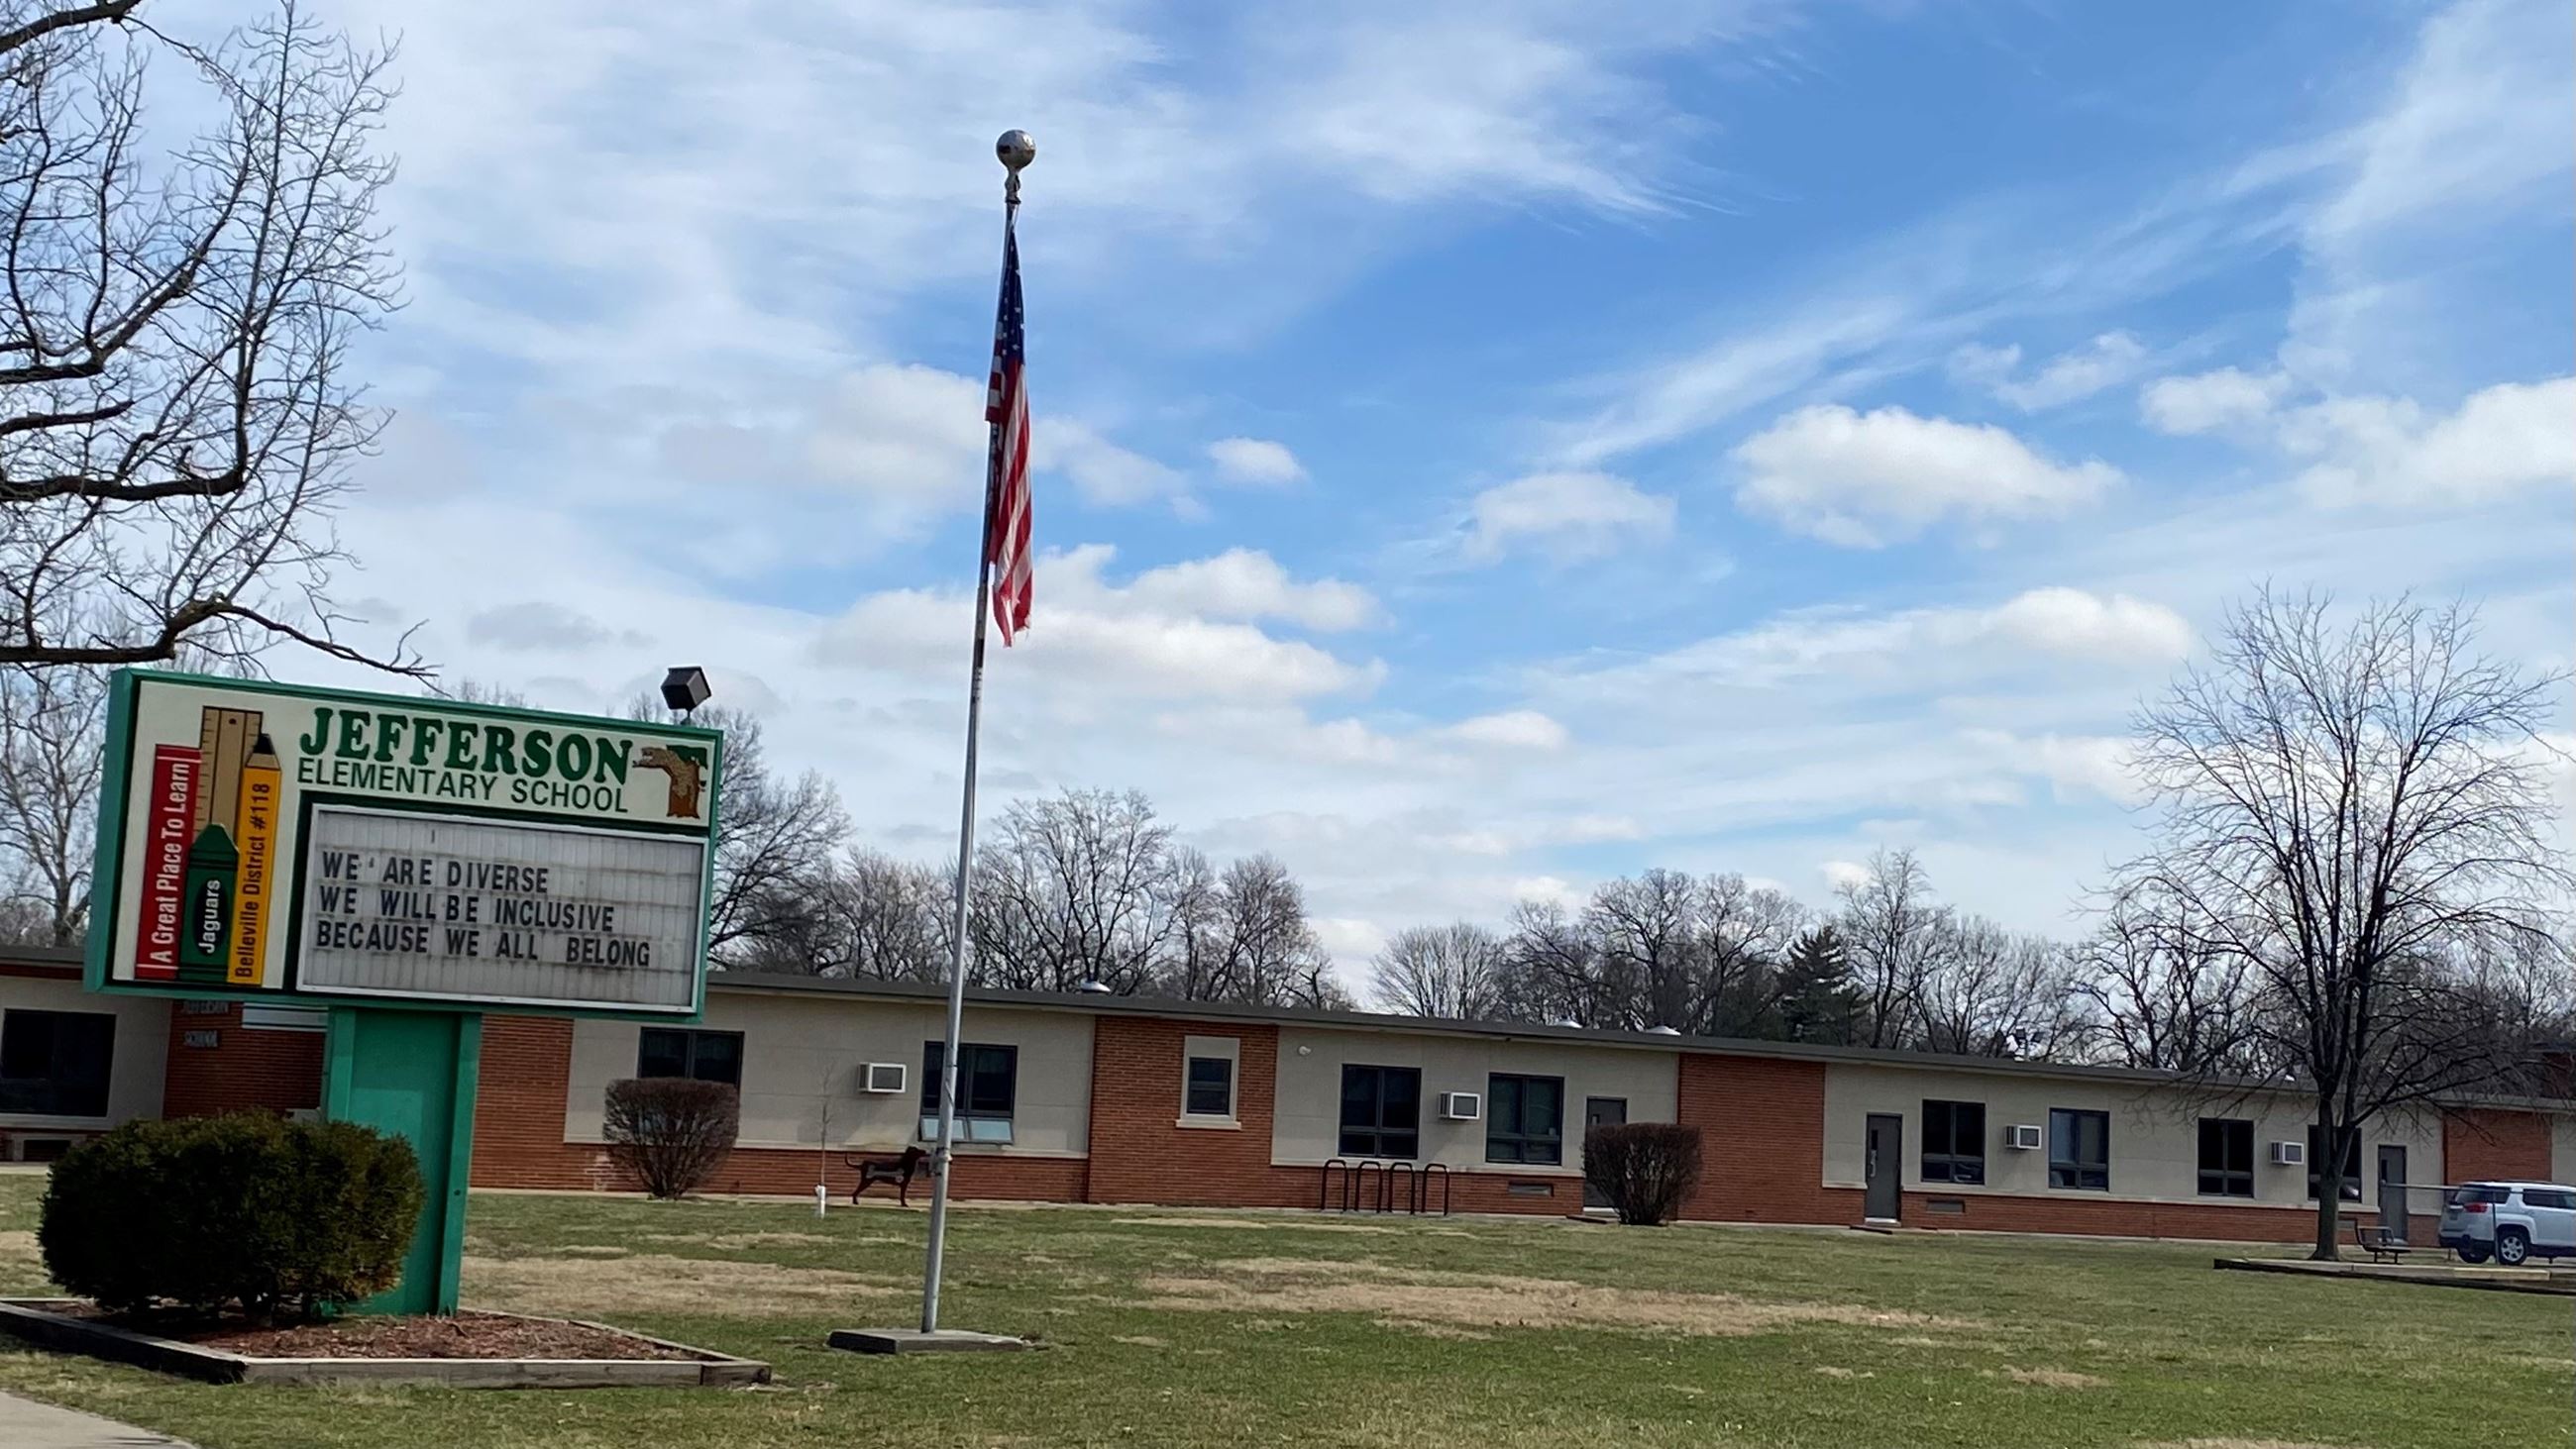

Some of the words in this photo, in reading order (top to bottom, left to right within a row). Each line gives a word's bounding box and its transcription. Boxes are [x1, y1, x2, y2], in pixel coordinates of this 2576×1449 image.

[299, 707, 633, 785] JEFFERSON
[162, 763, 190, 813] Learn
[250, 782, 270, 829] #118
[297, 757, 497, 800] ELEMENTARY
[510, 778, 628, 813] SCHOOL
[161, 818, 185, 839] To
[156, 842, 183, 891] Place
[242, 836, 266, 896] District
[322, 851, 360, 880] WE
[382, 857, 433, 885] ARE
[448, 861, 549, 893] DIVERSE
[151, 896, 178, 945] Great
[198, 880, 221, 954] Jaguars
[320, 885, 358, 914] WE
[380, 889, 436, 920] WILL
[446, 894, 480, 923] BE
[495, 897, 614, 932] INCLUSIVE
[150, 951, 173, 964] A
[235, 901, 260, 978] Belleville
[316, 920, 429, 953] BECAUSE
[447, 928, 480, 957] WE
[495, 932, 538, 961] ALL
[566, 937, 650, 967] BELONG
